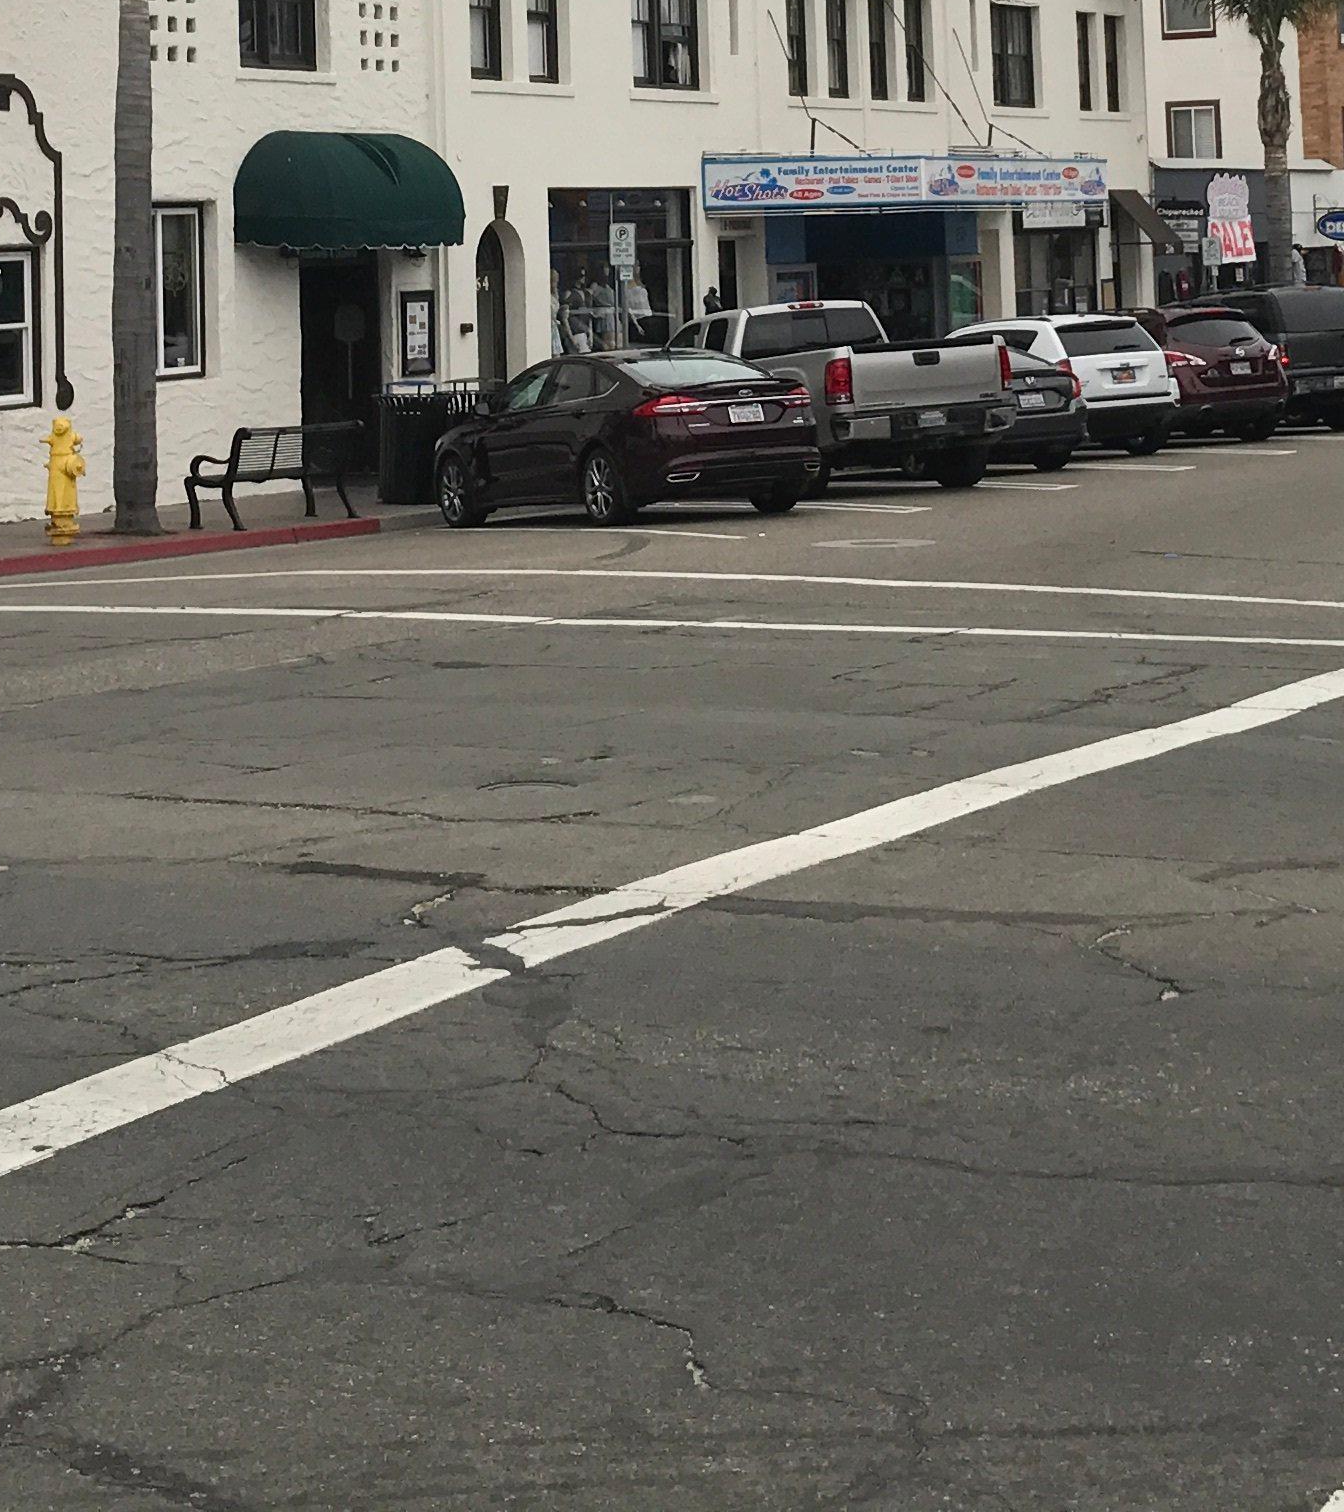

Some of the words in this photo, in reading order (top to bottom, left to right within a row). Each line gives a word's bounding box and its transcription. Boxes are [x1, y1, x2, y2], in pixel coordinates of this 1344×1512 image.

[778, 167, 810, 177] Family
[813, 165, 884, 175] Entertainment
[886, 165, 919, 173] Center
[710, 179, 742, 200] Hot
[740, 182, 790, 200] Shots
